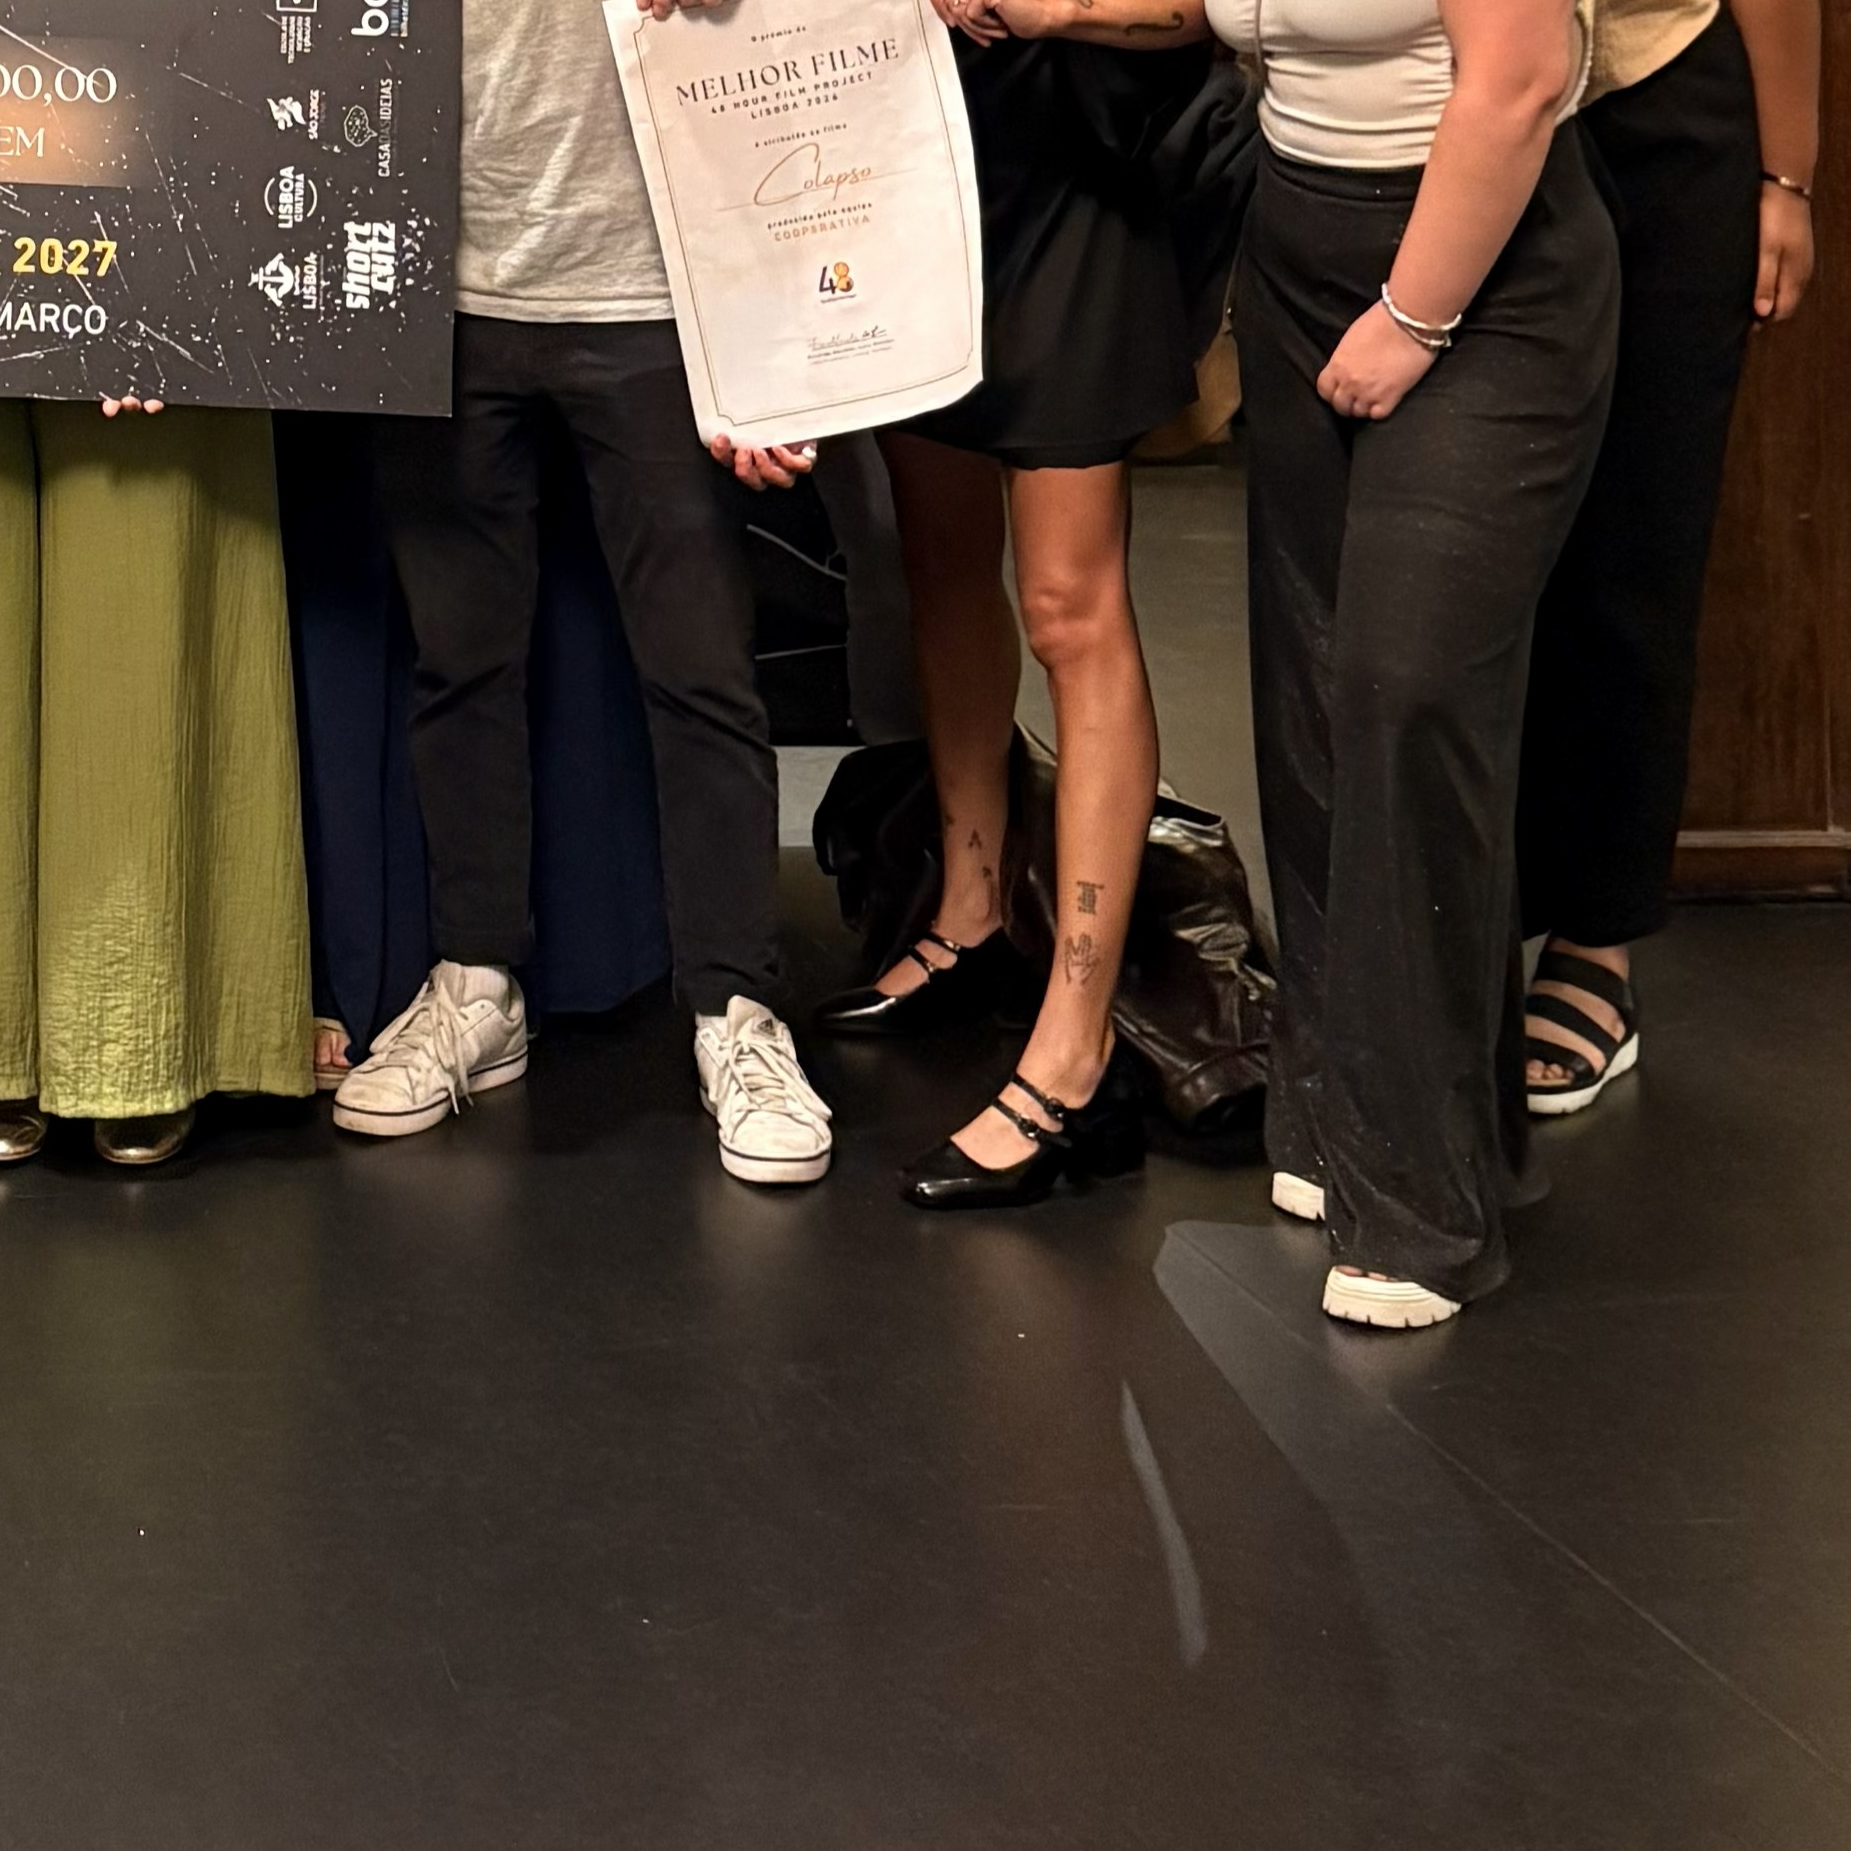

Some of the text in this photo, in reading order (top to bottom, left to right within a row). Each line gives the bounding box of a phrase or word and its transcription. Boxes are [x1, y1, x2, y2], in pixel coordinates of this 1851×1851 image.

[676, 38, 899, 106] MELHOR FILME
[733, 95, 768, 110] HOUR
[775, 87, 807, 100] FILM
[813, 71, 873, 92] PROJECT
[750, 102, 799, 120] LISBOA
[278, 166, 295, 229] LISBOA
[293, 173, 305, 222] CULTURA
[754, 143, 871, 207] Colapso
[774, 214, 870, 241] COOPERATIVA
[13, 236, 118, 277] 2027
[303, 252, 317, 310] LISBOA
